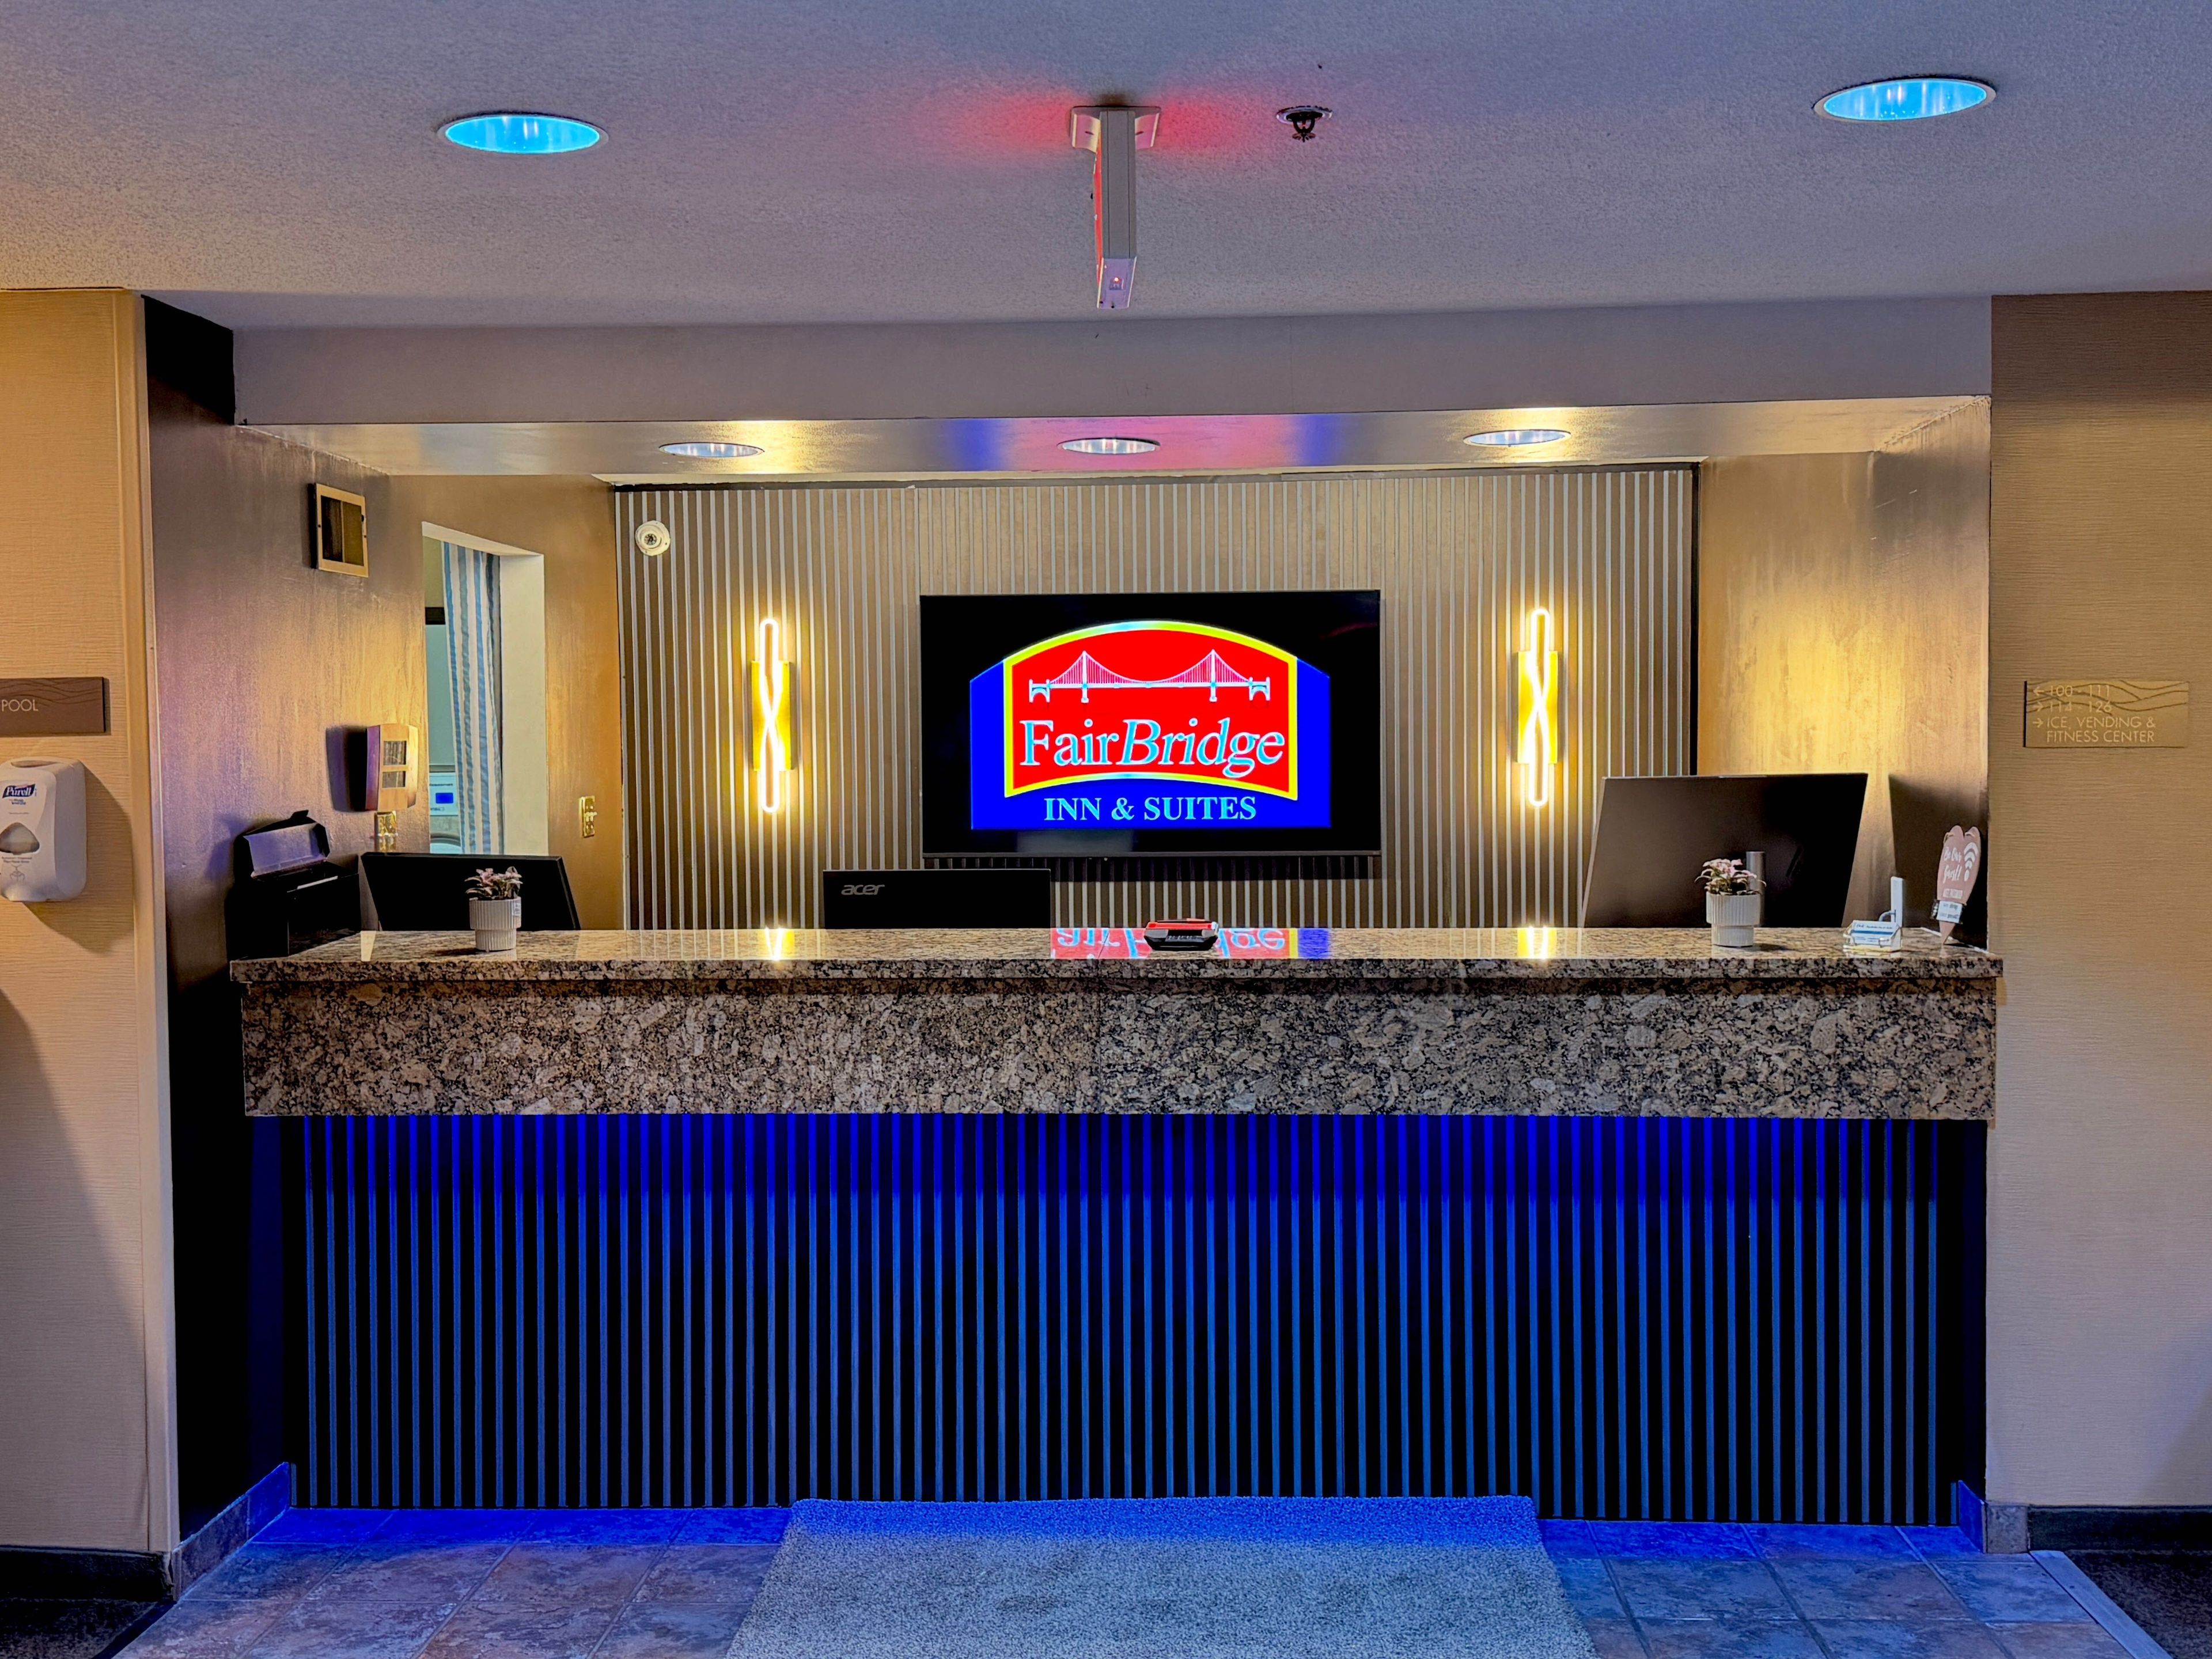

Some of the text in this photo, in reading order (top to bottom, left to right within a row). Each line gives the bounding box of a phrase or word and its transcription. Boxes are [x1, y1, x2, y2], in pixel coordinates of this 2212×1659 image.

[2050, 685, 2073, 697] 100
[2088, 684, 2110, 697] 111
[1, 699, 39, 713] POOL
[2050, 701, 2073, 713] 114
[2088, 700, 2113, 713] 126
[2046, 716, 2156, 730] ICE, VENDING &
[2046, 730, 2156, 743] FITNESS CENTER
[1019, 717, 1285, 778] FairBridge
[1044, 796, 1257, 821] INN & SUITES
[841, 884, 885, 895] acer
